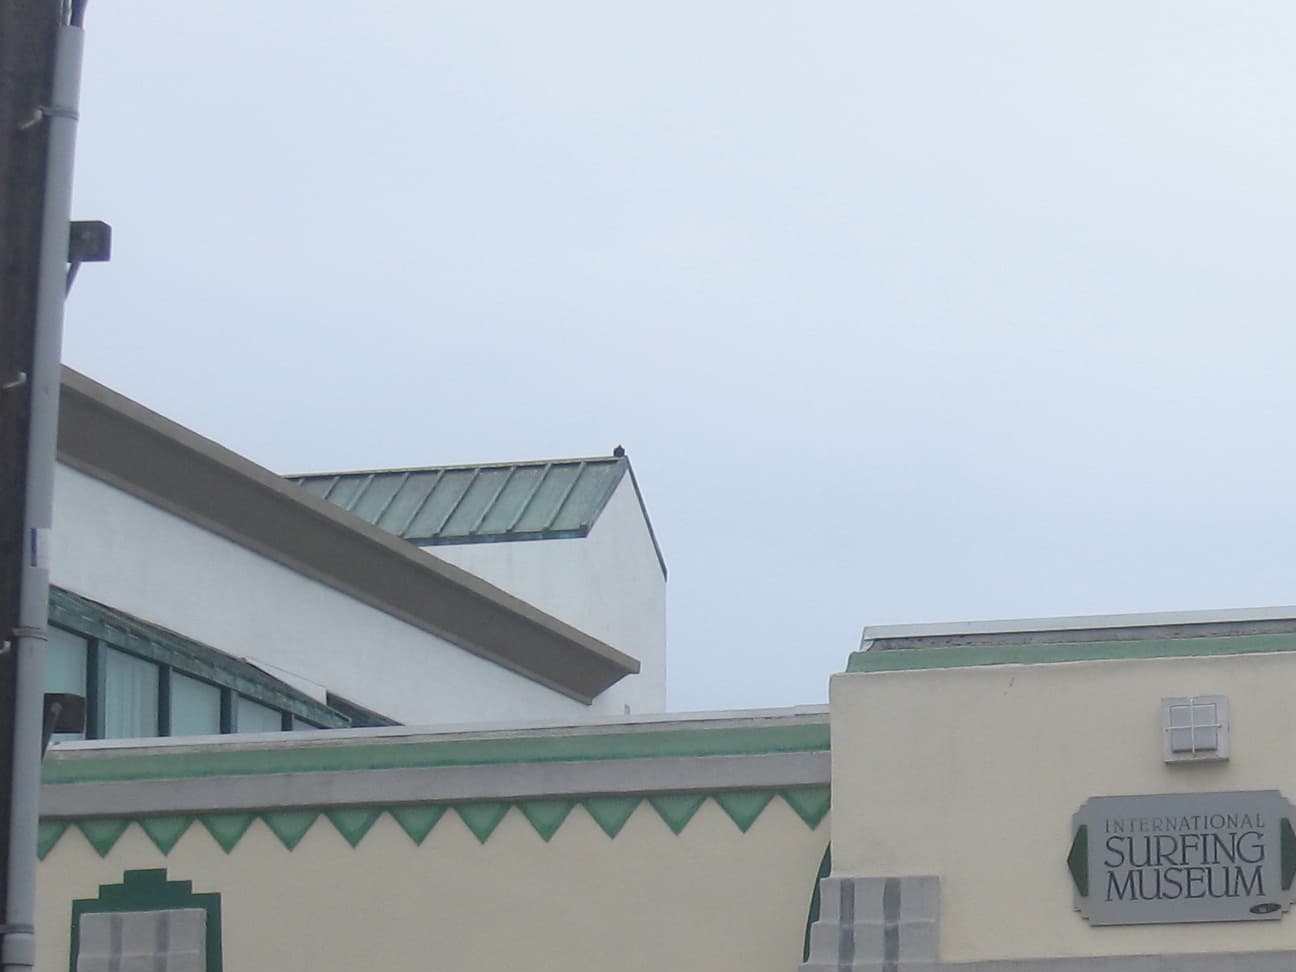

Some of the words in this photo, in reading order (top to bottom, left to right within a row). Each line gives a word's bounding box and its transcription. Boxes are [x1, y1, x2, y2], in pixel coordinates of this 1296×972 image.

[1104, 812, 1265, 834] INTERNATIONAL
[1104, 831, 1265, 868] SURFING
[1104, 865, 1266, 901] MUSEUM
